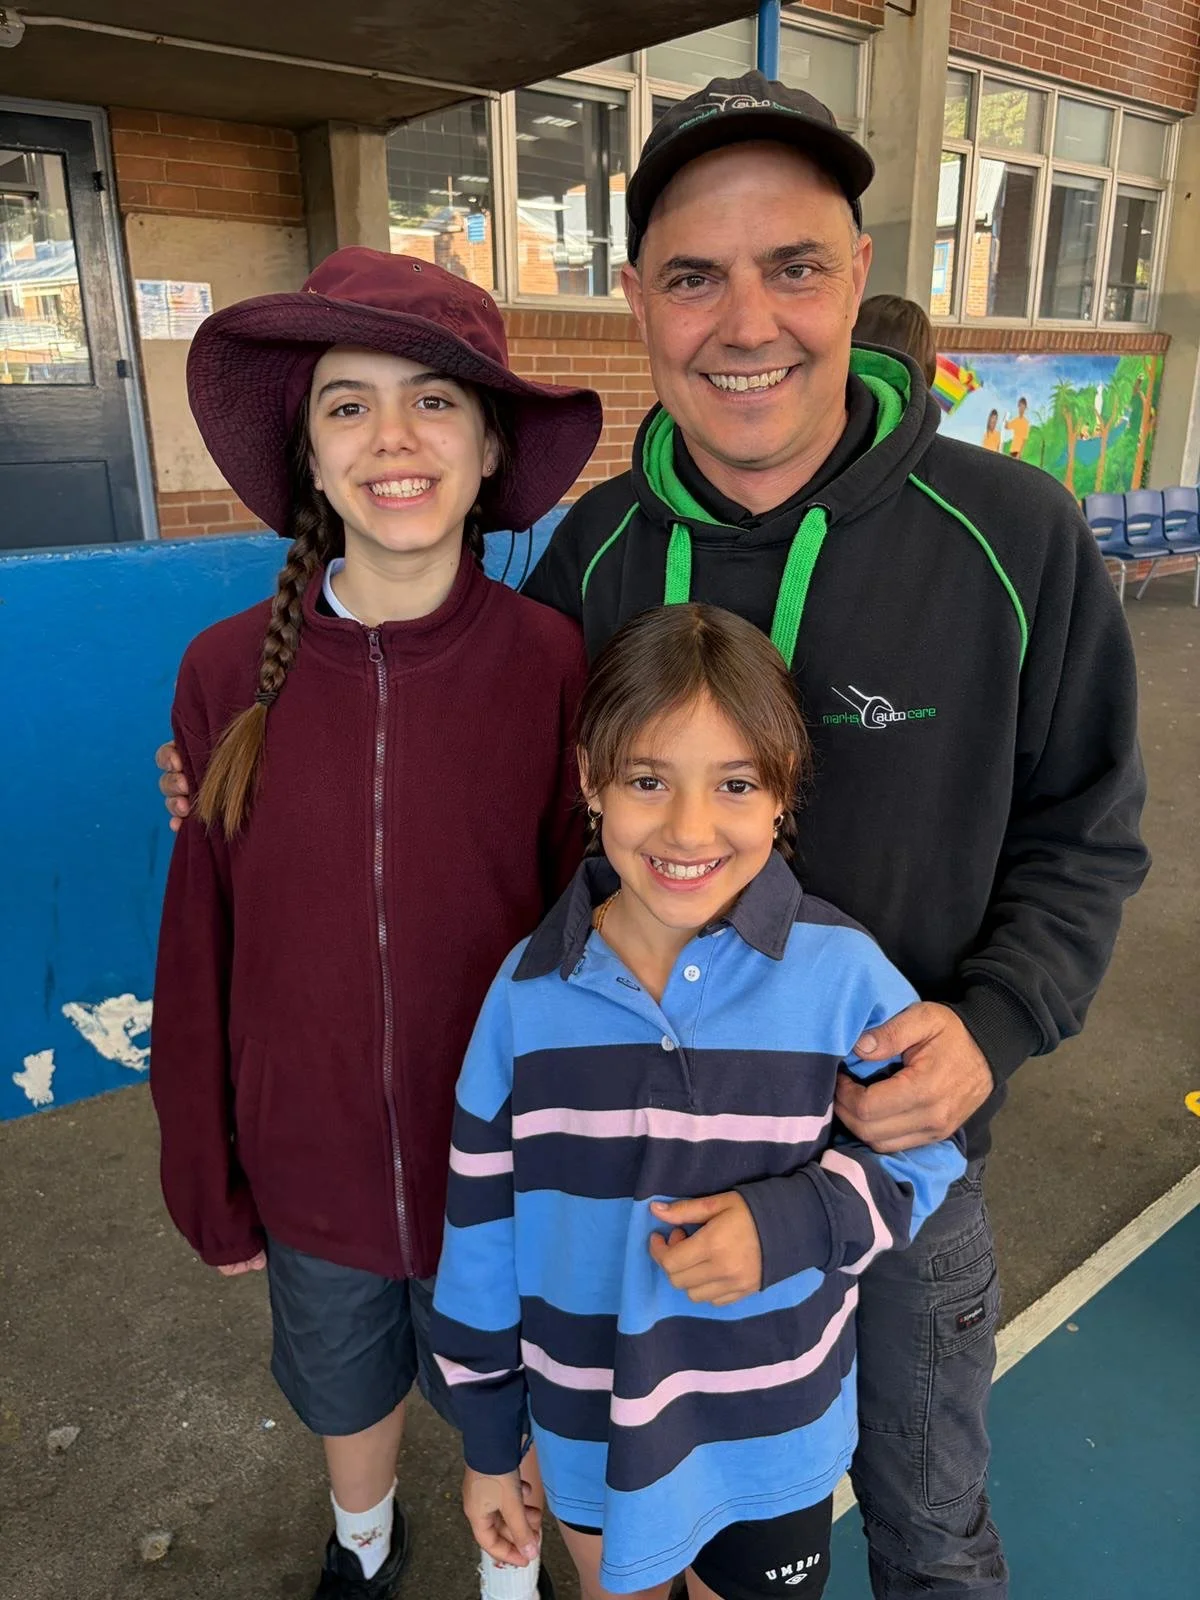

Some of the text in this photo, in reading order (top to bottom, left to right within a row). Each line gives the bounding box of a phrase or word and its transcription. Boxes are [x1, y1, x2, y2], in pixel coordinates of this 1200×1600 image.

[736, 99, 771, 108] auto
[822, 707, 936, 724] marks auto care
[765, 1553, 820, 1580] UMBRO
